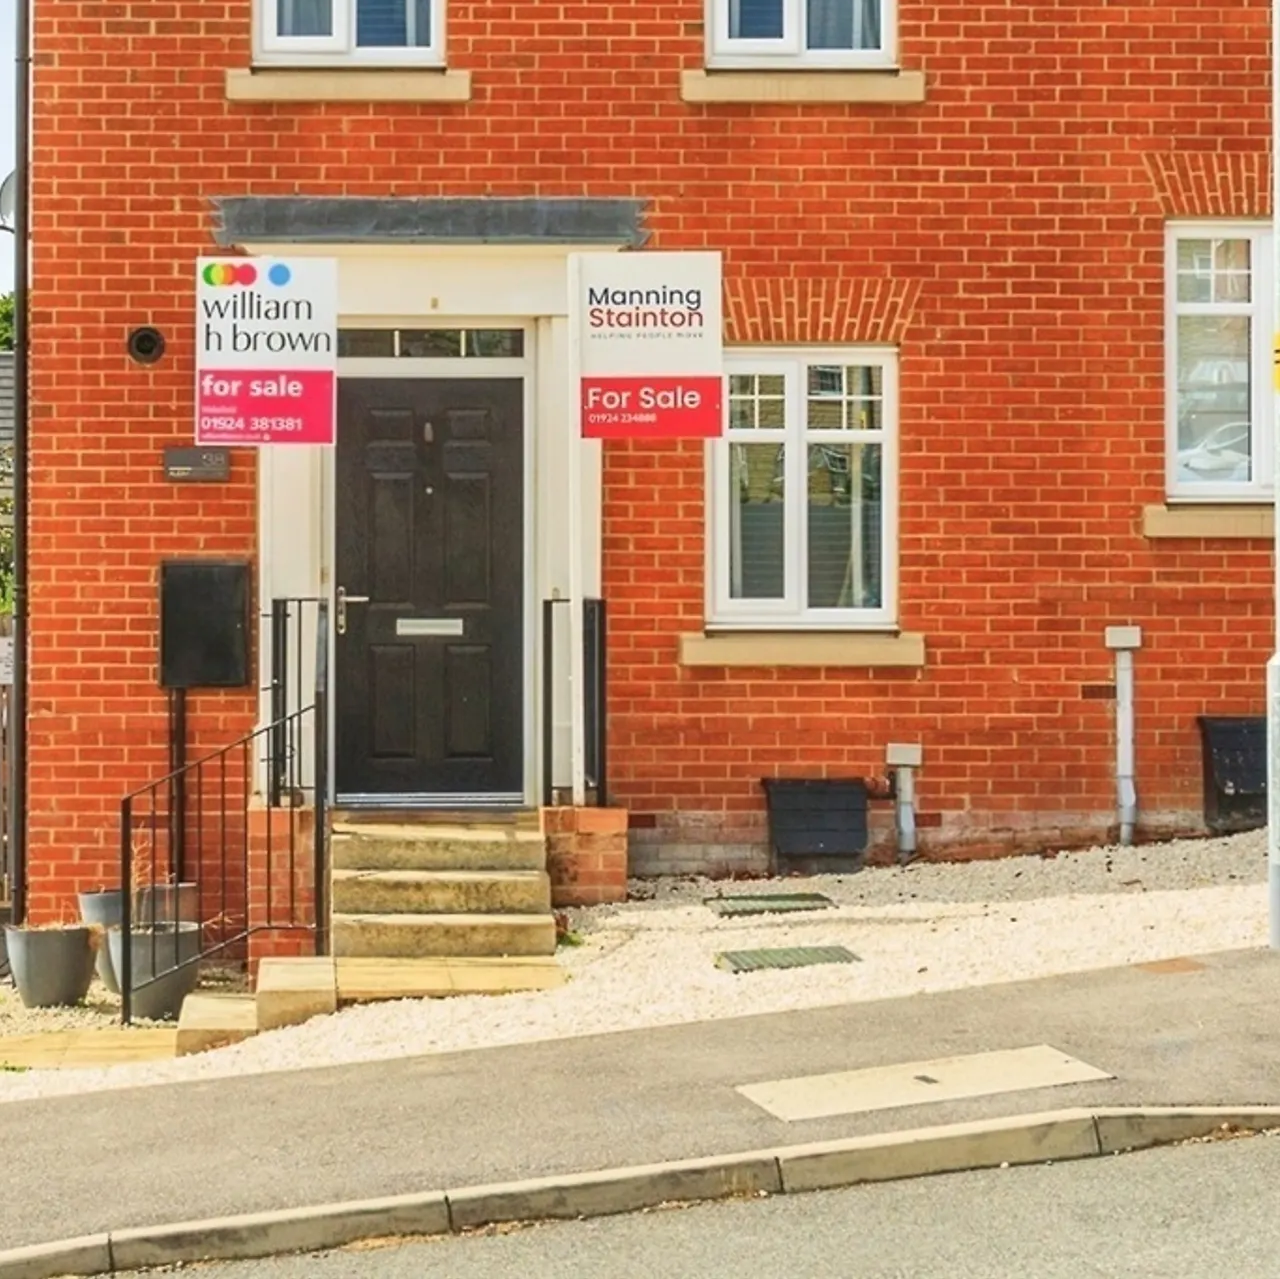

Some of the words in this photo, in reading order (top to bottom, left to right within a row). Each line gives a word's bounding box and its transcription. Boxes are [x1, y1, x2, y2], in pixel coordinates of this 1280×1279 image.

[202, 291, 312, 320] william
[588, 285, 702, 311] Manning
[589, 307, 704, 328] Stainton
[205, 323, 222, 351] h
[232, 323, 331, 352] brown
[202, 374, 243, 397] for
[249, 374, 303, 397] sale
[587, 387, 632, 409] For
[639, 386, 701, 410] Sale
[201, 416, 245, 431] 01924
[249, 416, 303, 431] 381381
[588, 413, 619, 424] 01924
